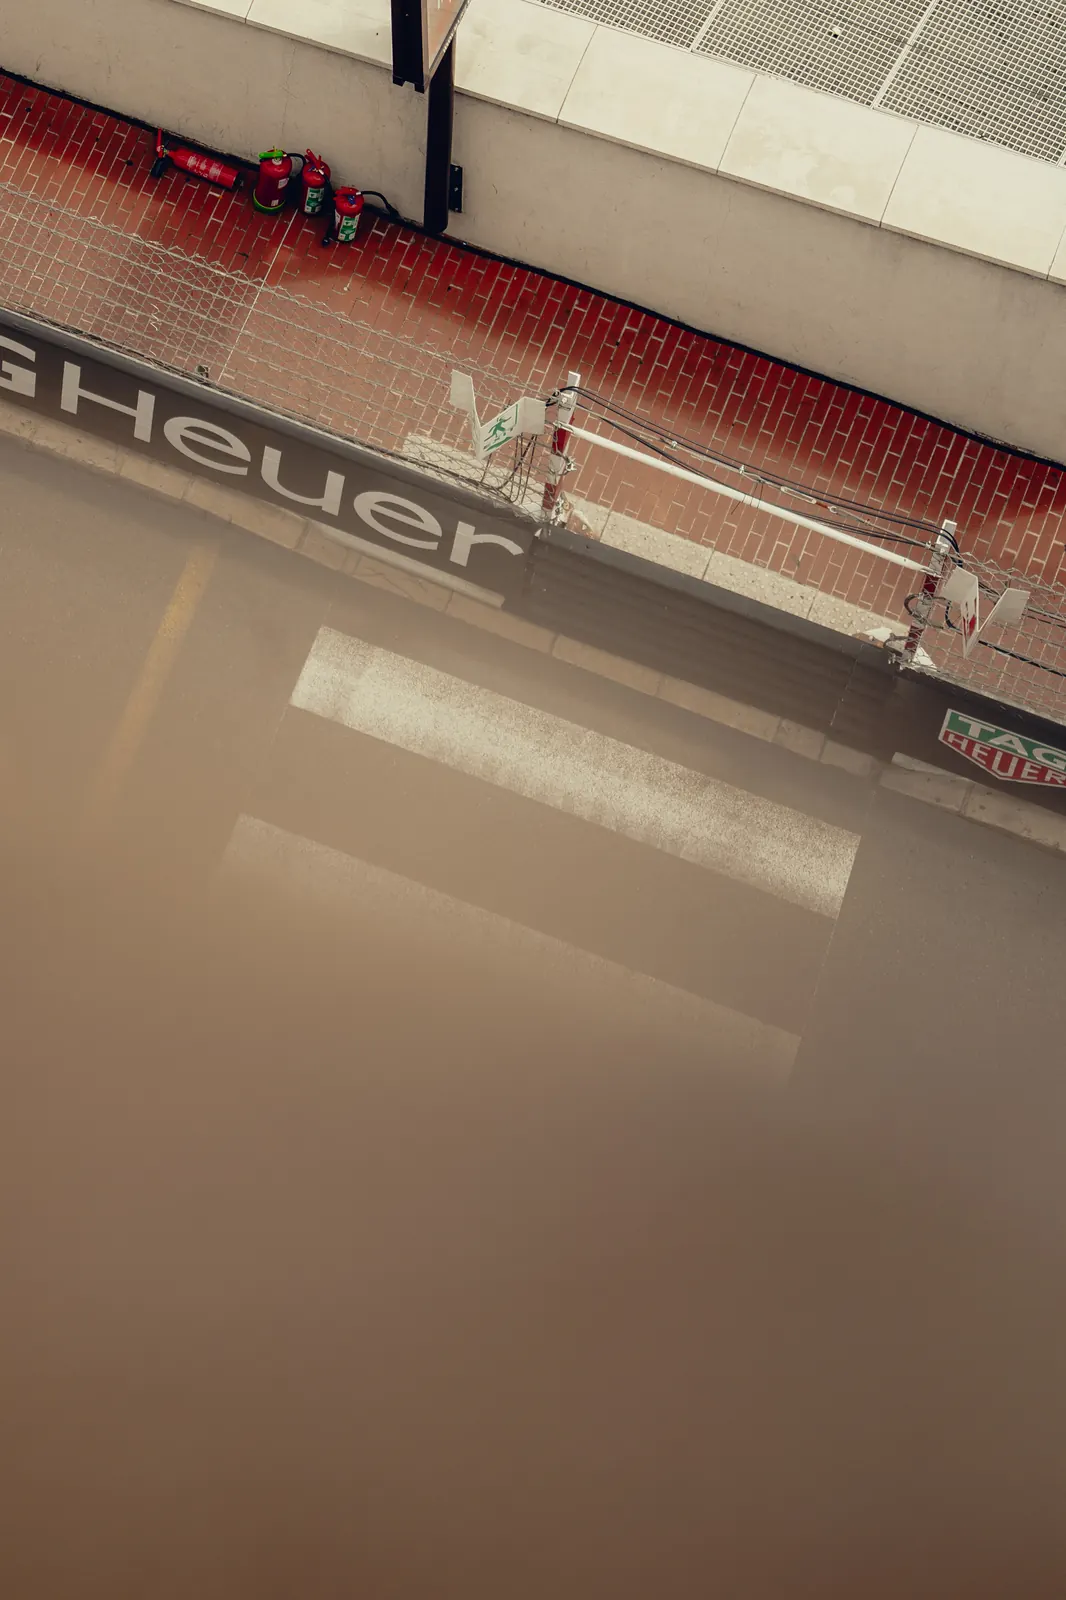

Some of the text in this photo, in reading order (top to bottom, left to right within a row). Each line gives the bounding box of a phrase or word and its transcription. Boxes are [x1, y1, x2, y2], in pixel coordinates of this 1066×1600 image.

[60, 361, 525, 567] Heuer
[947, 733, 1066, 784] HEUER
[958, 715, 1066, 771] TAG
